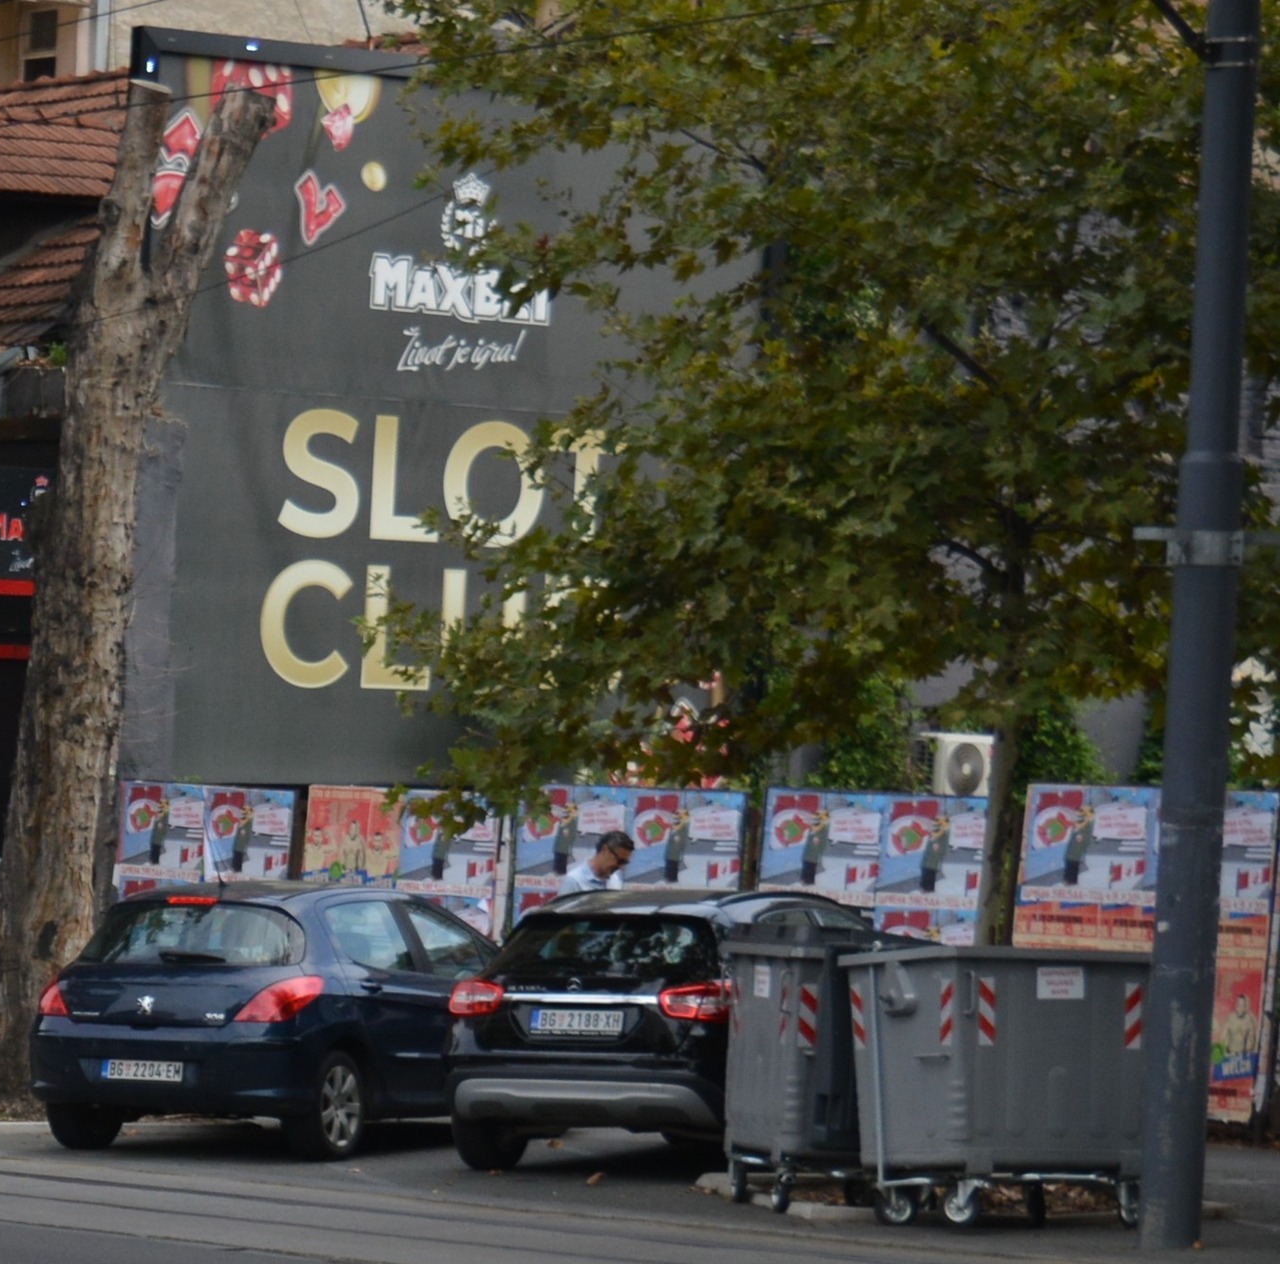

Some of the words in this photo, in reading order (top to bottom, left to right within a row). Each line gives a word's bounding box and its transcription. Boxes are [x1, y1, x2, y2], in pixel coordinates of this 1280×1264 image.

[369, 253, 550, 326] MAXB
[397, 327, 457, 371] Život
[470, 329, 527, 370] igra!
[277, 408, 626, 548] SLOT
[260, 559, 622, 692] CL
[541, 1012, 556, 1028] BG
[109, 1062, 123, 1076] BG
